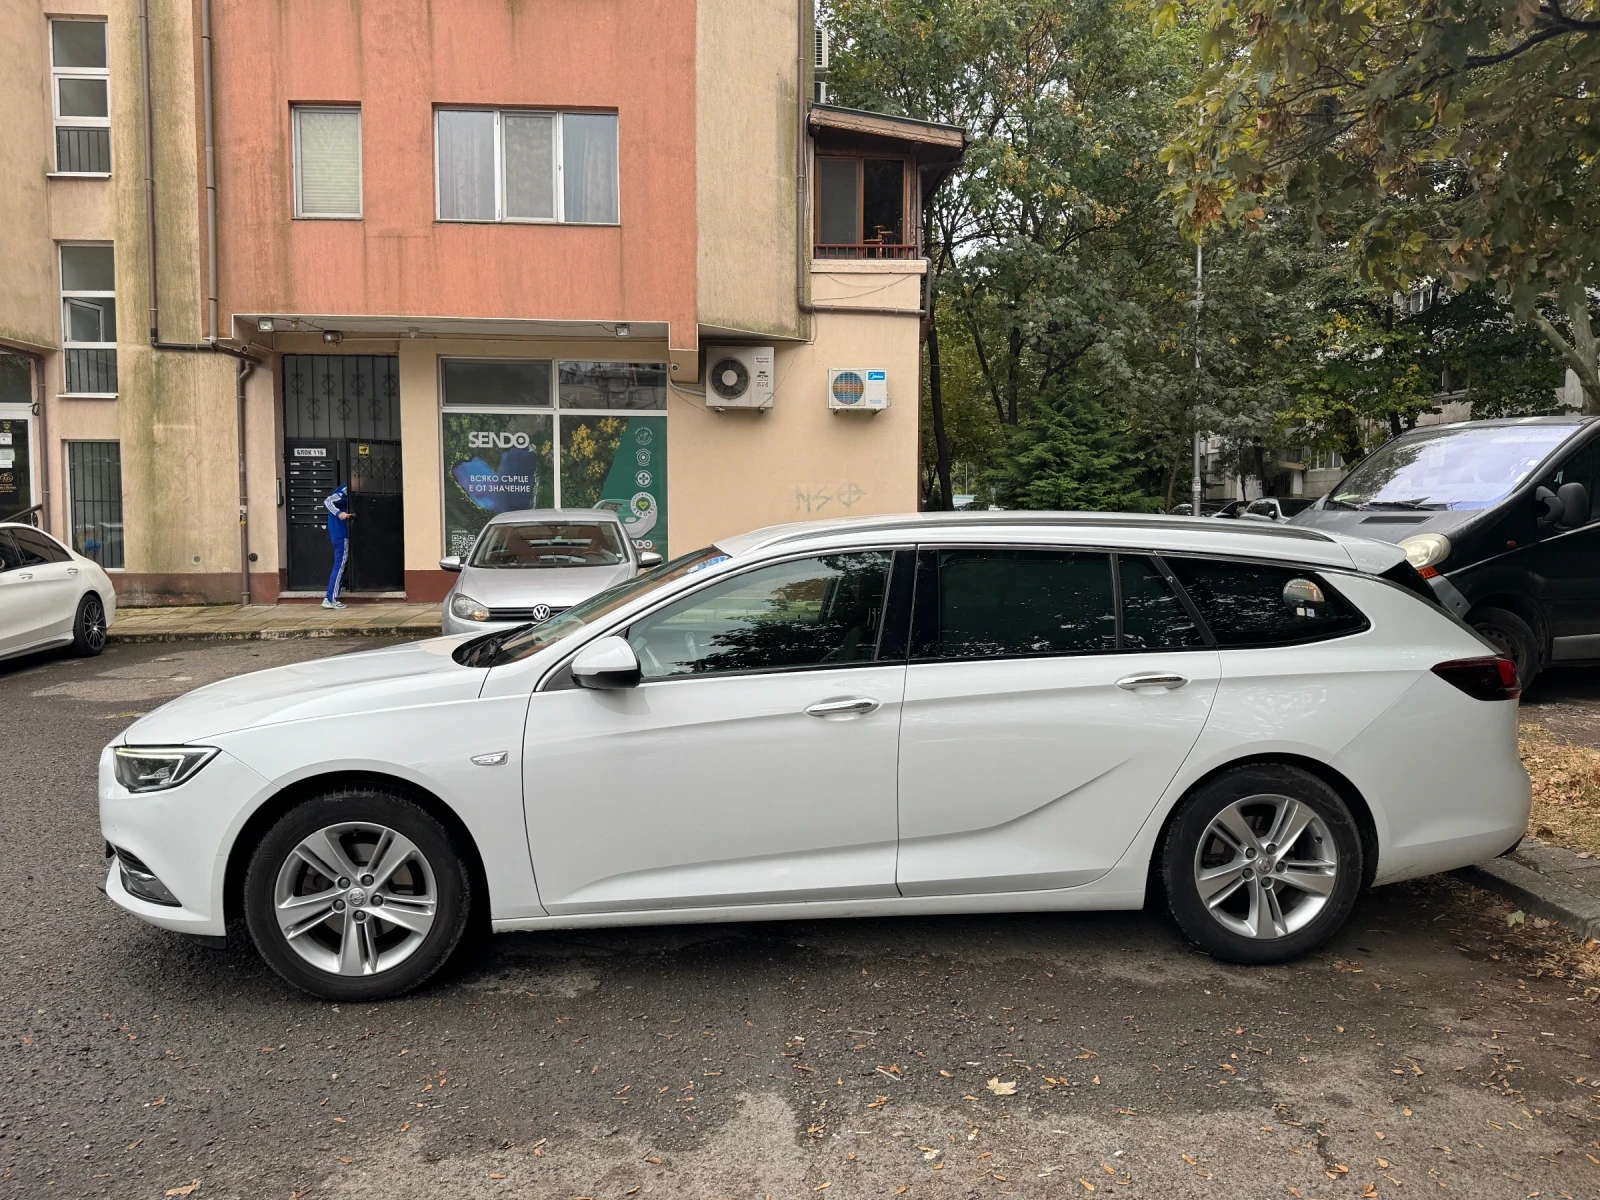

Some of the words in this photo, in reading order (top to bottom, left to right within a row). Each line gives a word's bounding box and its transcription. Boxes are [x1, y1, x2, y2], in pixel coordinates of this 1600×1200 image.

[468, 431, 530, 449] SENDO
[470, 474, 499, 483] ВСЯКО
[501, 475, 529, 484] СЪРЦЕ
[468, 484, 474, 492] Е
[475, 484, 487, 492] ОТ
[488, 485, 531, 493] ЗНАЧЕНИЕ
